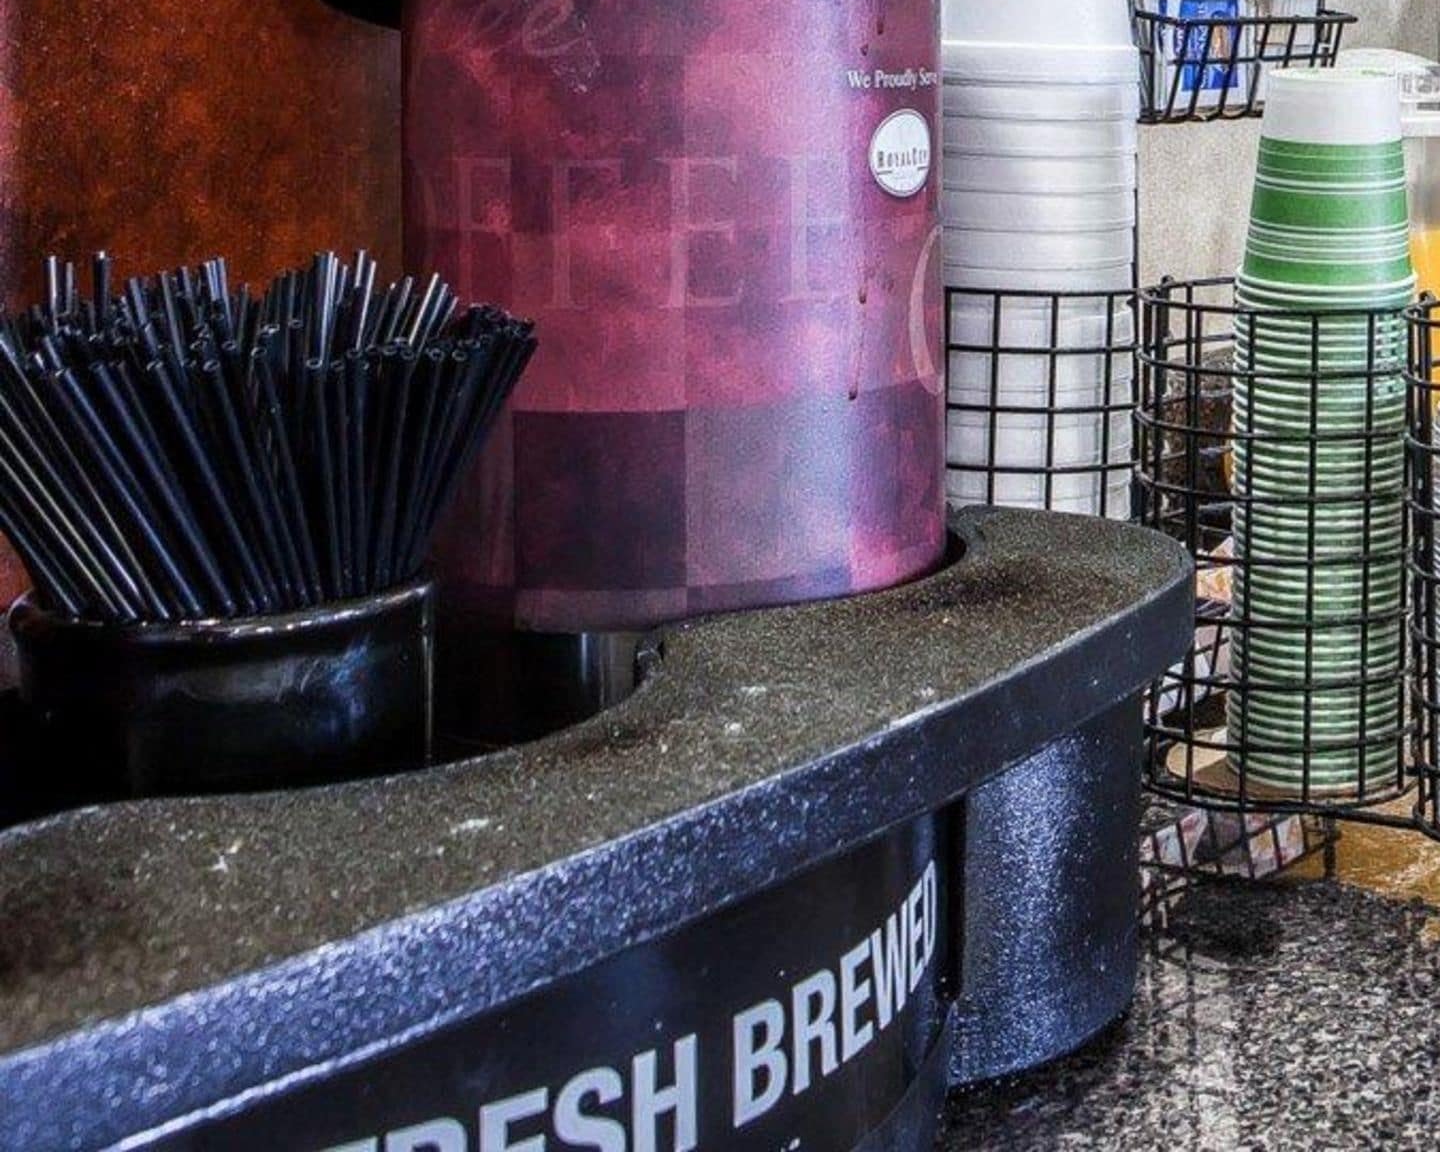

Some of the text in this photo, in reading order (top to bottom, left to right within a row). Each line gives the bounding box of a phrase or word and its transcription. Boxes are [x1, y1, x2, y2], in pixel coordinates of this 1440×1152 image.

[847, 69, 871, 89] We
[874, 67, 917, 91] Proudly
[320, 859, 937, 1152] ESH BREWED
